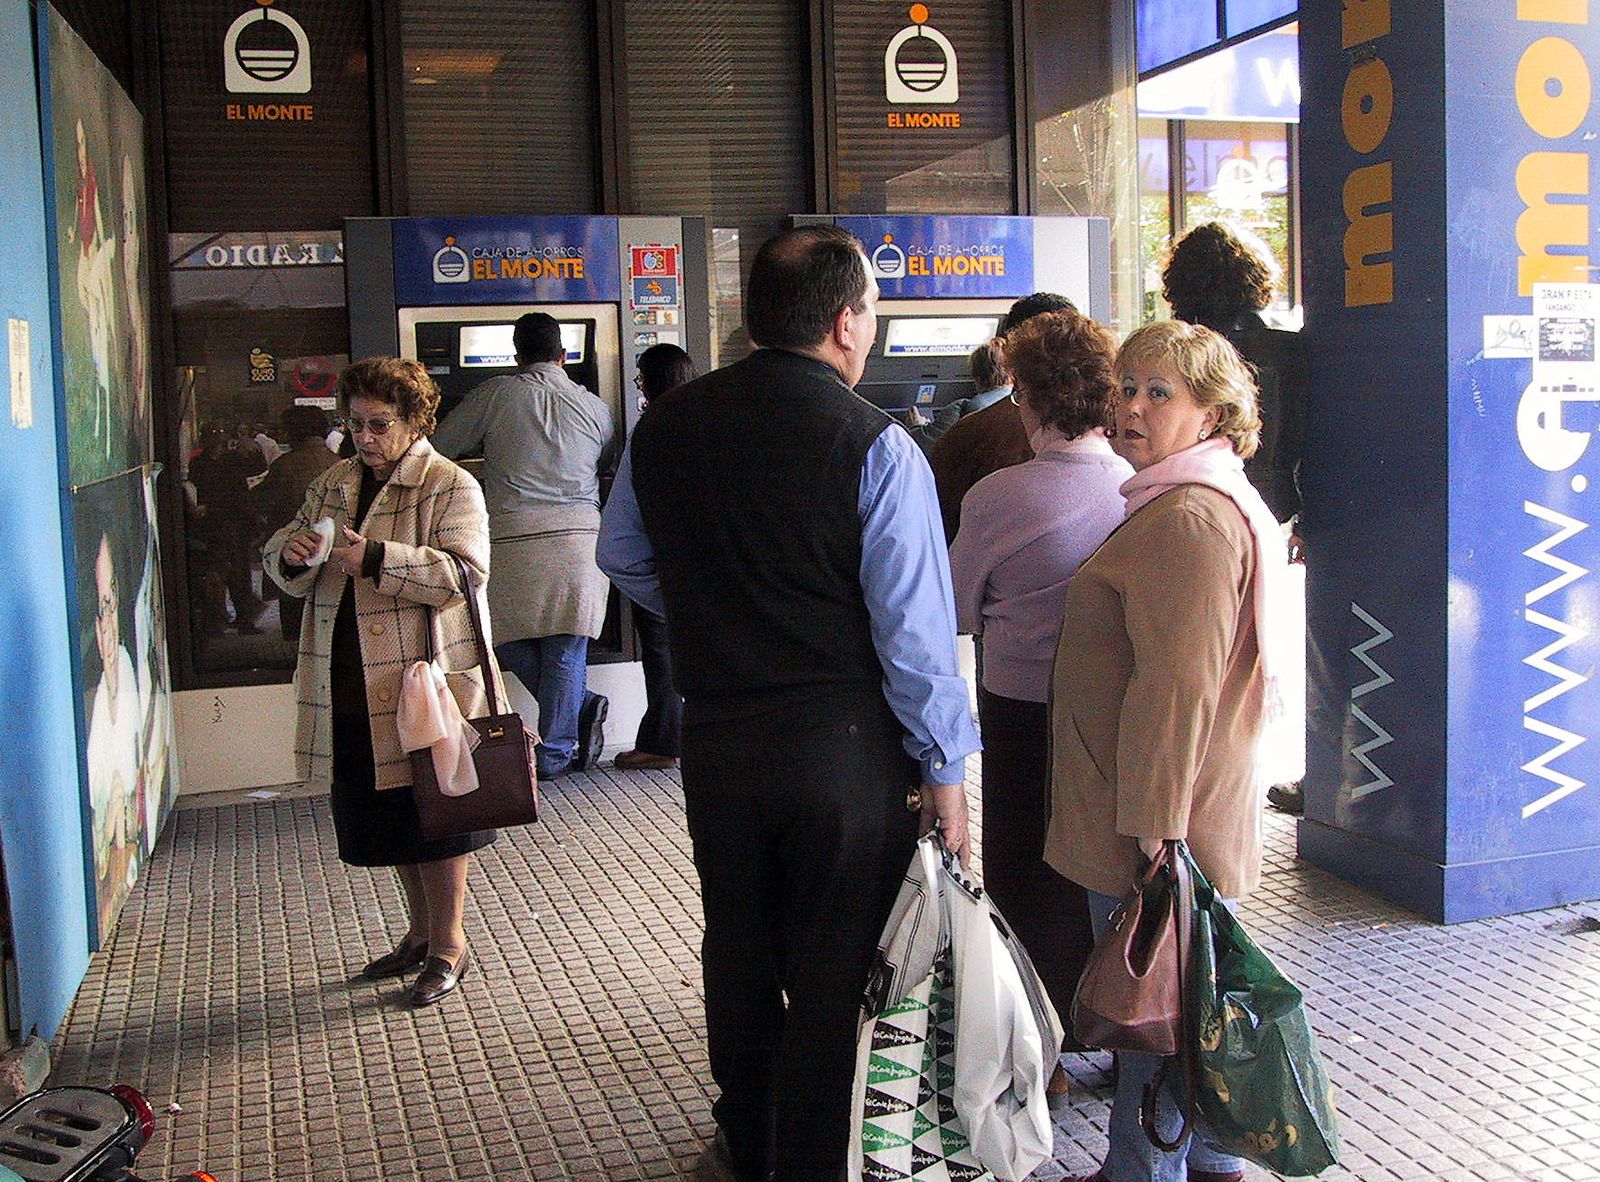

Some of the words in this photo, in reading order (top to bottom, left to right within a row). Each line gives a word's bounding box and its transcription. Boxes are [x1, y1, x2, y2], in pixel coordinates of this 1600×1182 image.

[226, 104, 245, 120] EL
[248, 104, 314, 120] MONTE
[887, 113, 904, 127] EL
[905, 113, 961, 127] MONTE
[472, 247, 502, 258] CAJA
[507, 247, 522, 257] DE
[526, 247, 583, 257] AHORROS
[908, 245, 934, 256] CAJA
[938, 245, 952, 256] DE
[956, 245, 1004, 256] AHORROS
[473, 259, 498, 279] EL
[502, 258, 584, 279] MONTE
[909, 256, 930, 275] EL
[933, 256, 1005, 276] MONTE
